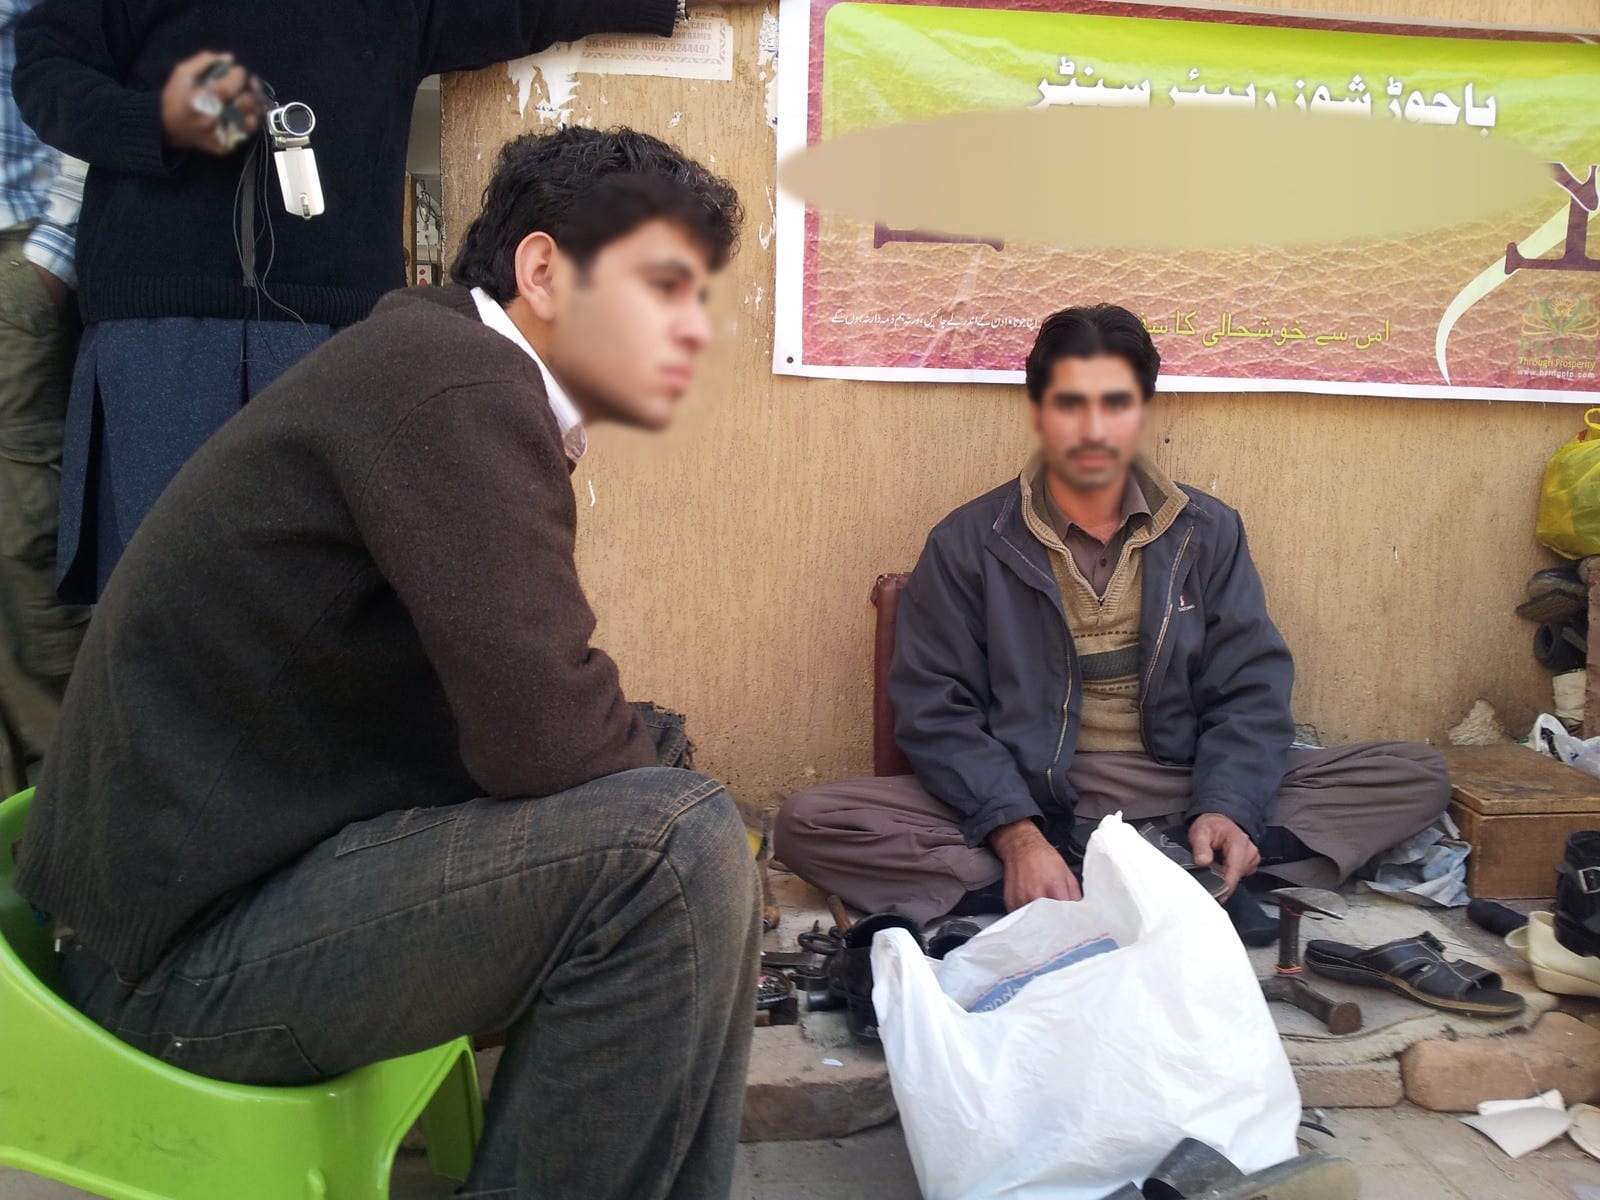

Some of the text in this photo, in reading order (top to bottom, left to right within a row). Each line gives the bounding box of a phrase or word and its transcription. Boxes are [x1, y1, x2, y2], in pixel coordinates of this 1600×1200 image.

[977, 312, 990, 326] کے
[1139, 310, 1389, 349] امن سے خوشحالی کا سف
[1519, 340, 1597, 358] PEACE
[1519, 357, 1596, 370] Through Prosperity
